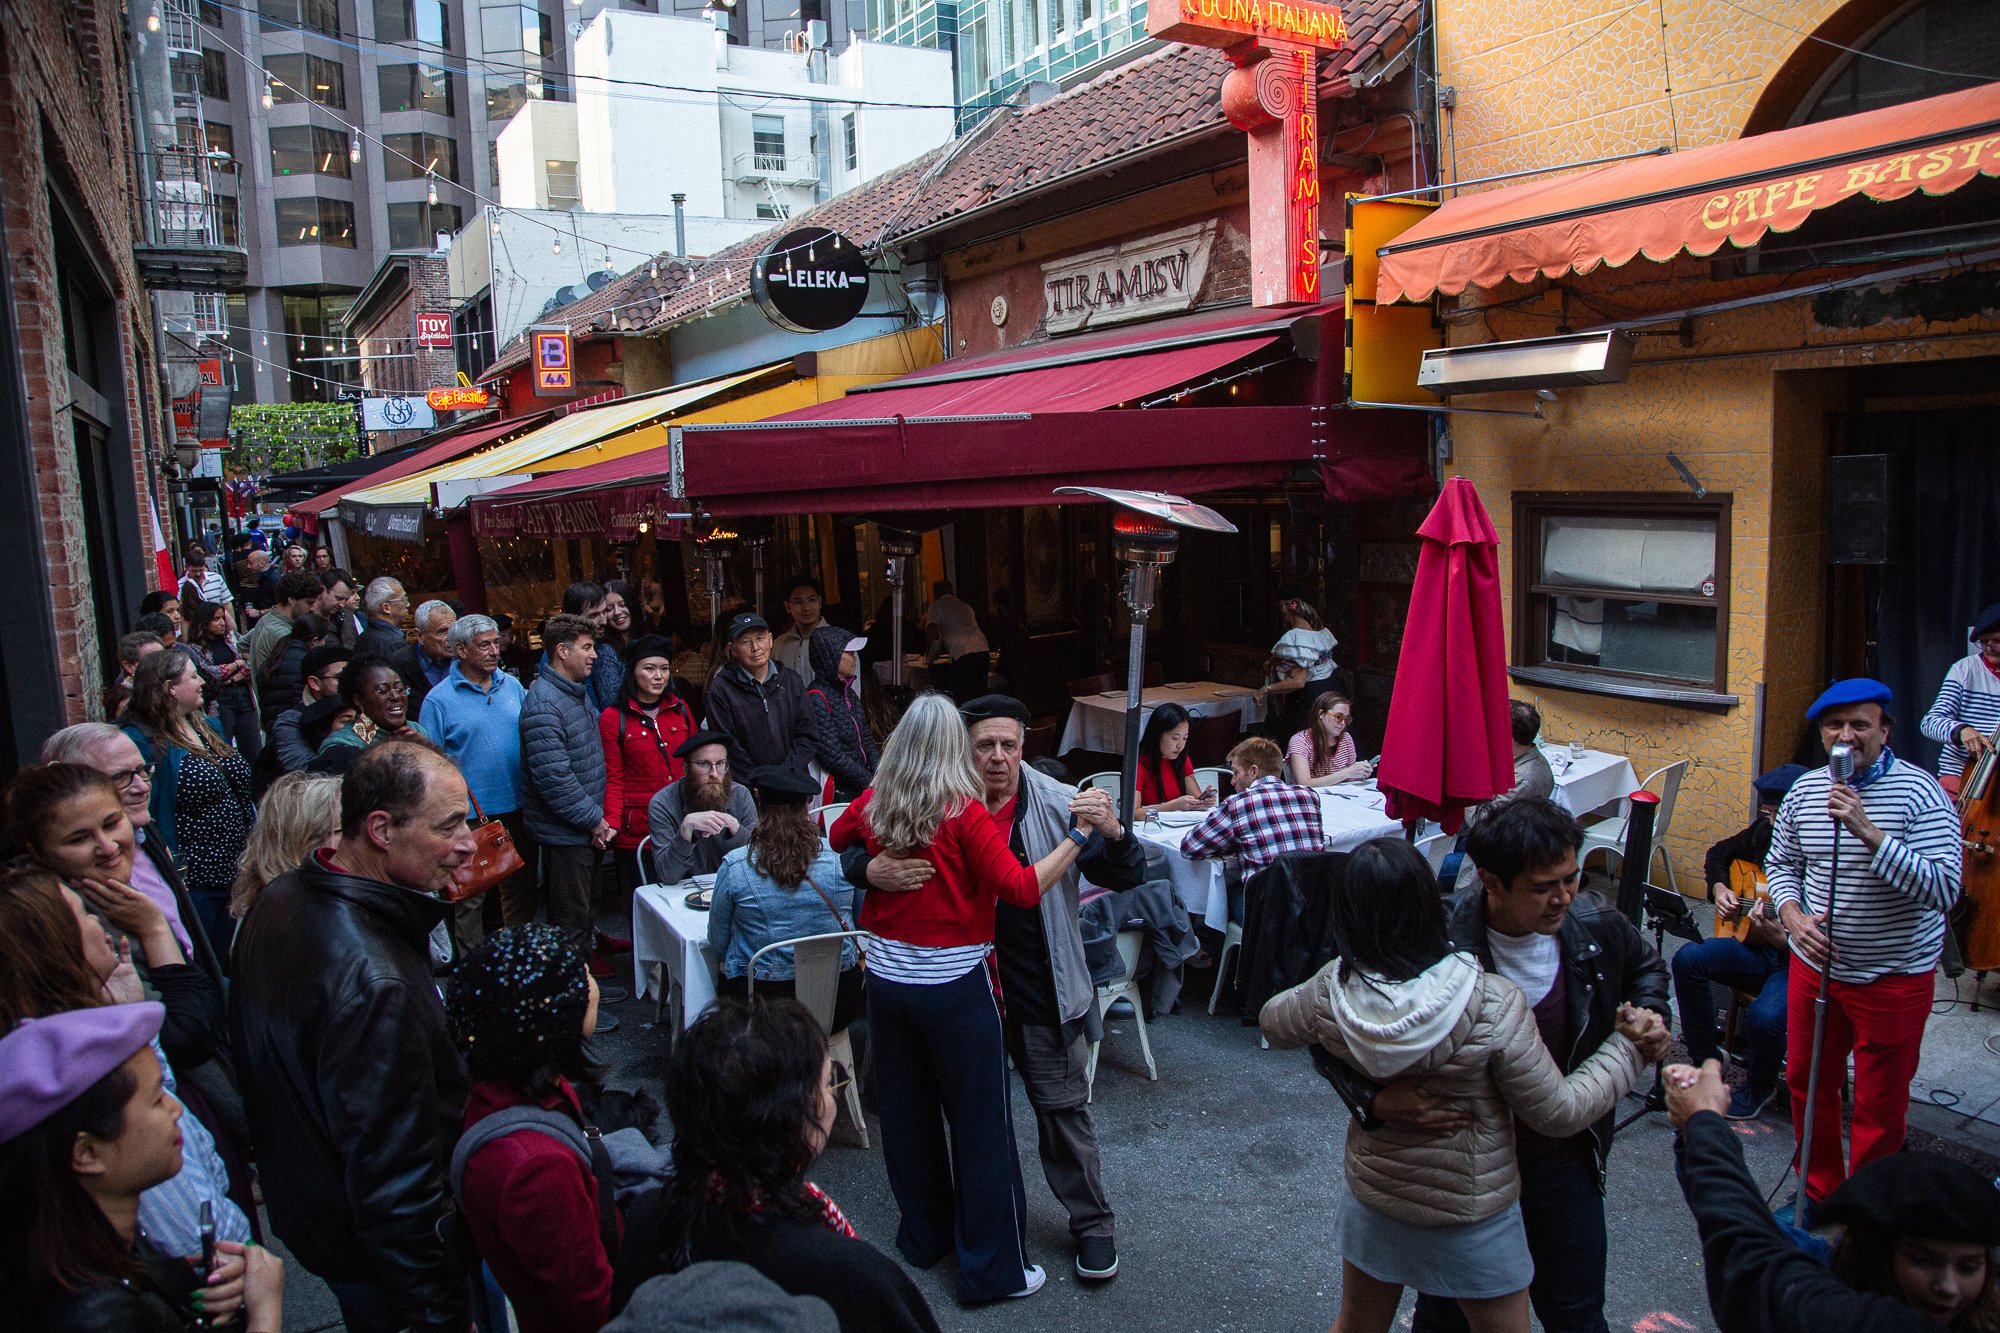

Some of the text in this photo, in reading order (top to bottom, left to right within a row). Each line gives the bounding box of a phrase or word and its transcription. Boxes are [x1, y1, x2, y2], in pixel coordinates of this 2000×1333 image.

[1187, 0, 1348, 42] CUCINA ITALIANA
[1702, 137, 2000, 230] CAFE BAST
[787, 270, 849, 288] LELEKA
[419, 319, 448, 331] TOY
[420, 331, 450, 340] Soldier
[542, 338, 566, 367] B
[545, 373, 566, 385] 44
[429, 390, 488, 410] Cafe Bastille
